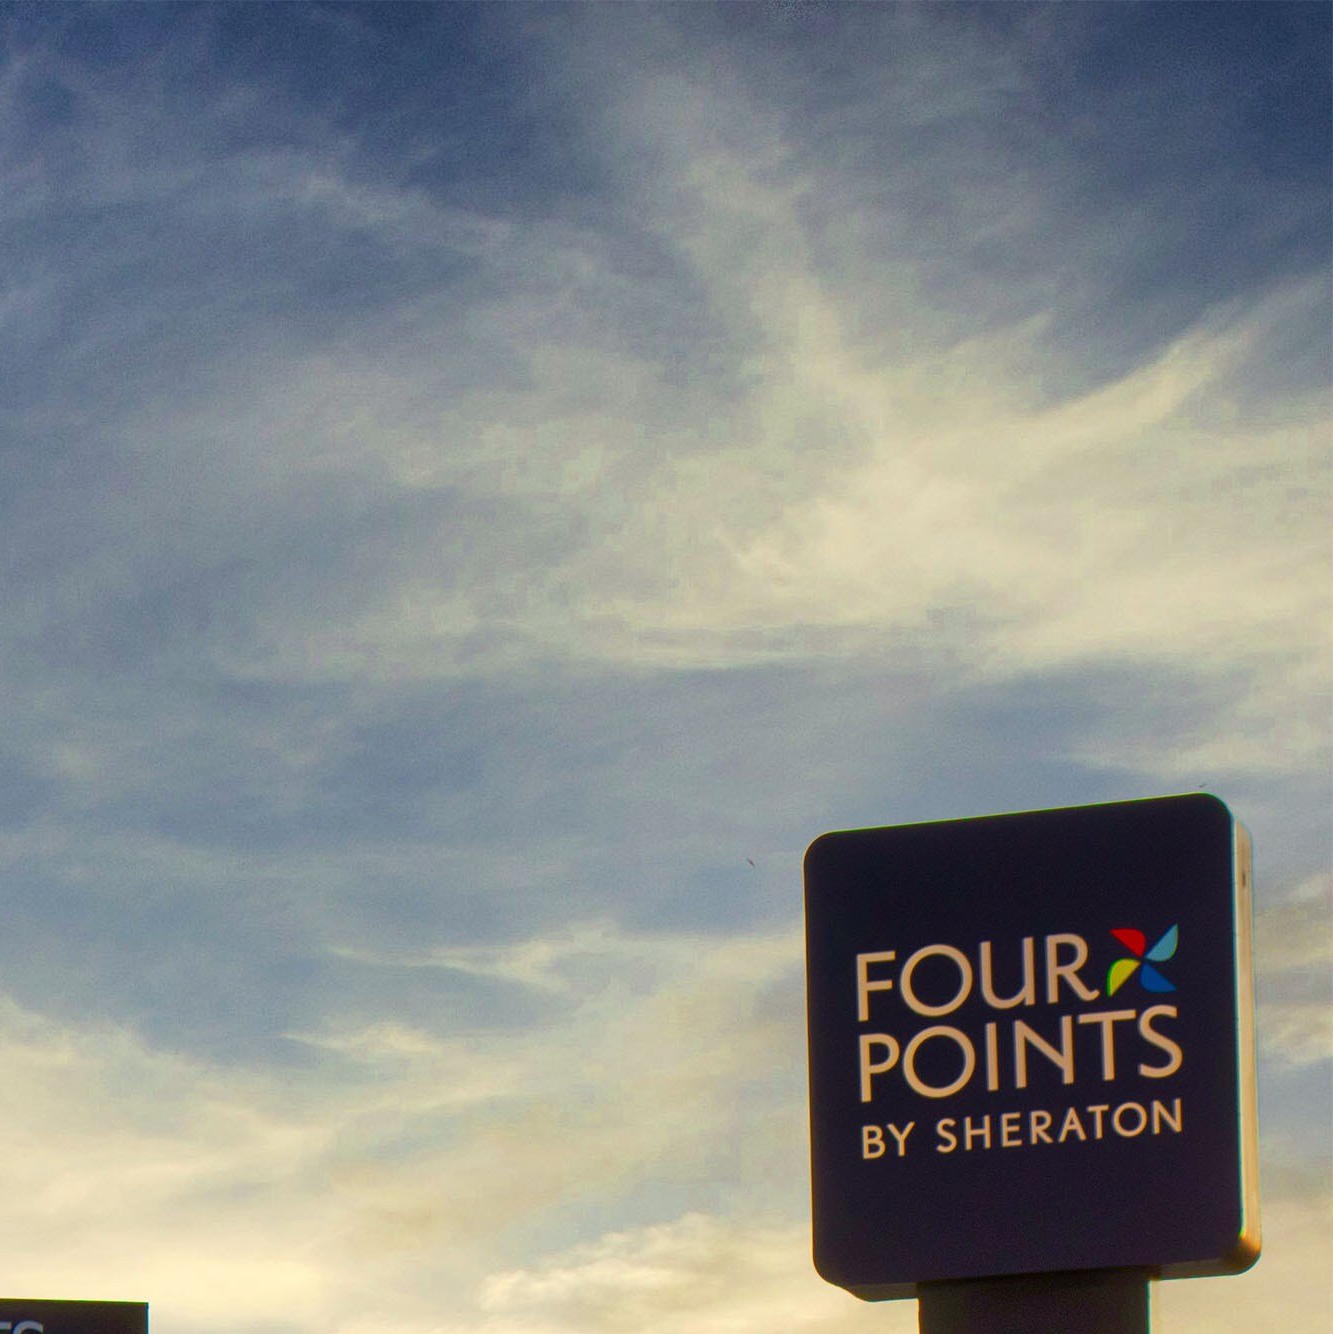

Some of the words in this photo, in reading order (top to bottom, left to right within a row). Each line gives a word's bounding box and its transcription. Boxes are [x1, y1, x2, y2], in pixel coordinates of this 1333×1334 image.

[856, 933, 1101, 1022] FOUR
[859, 1004, 1184, 1103] POINTS
[862, 1121, 915, 1160] BY
[936, 1098, 1183, 1153] SHERATON
